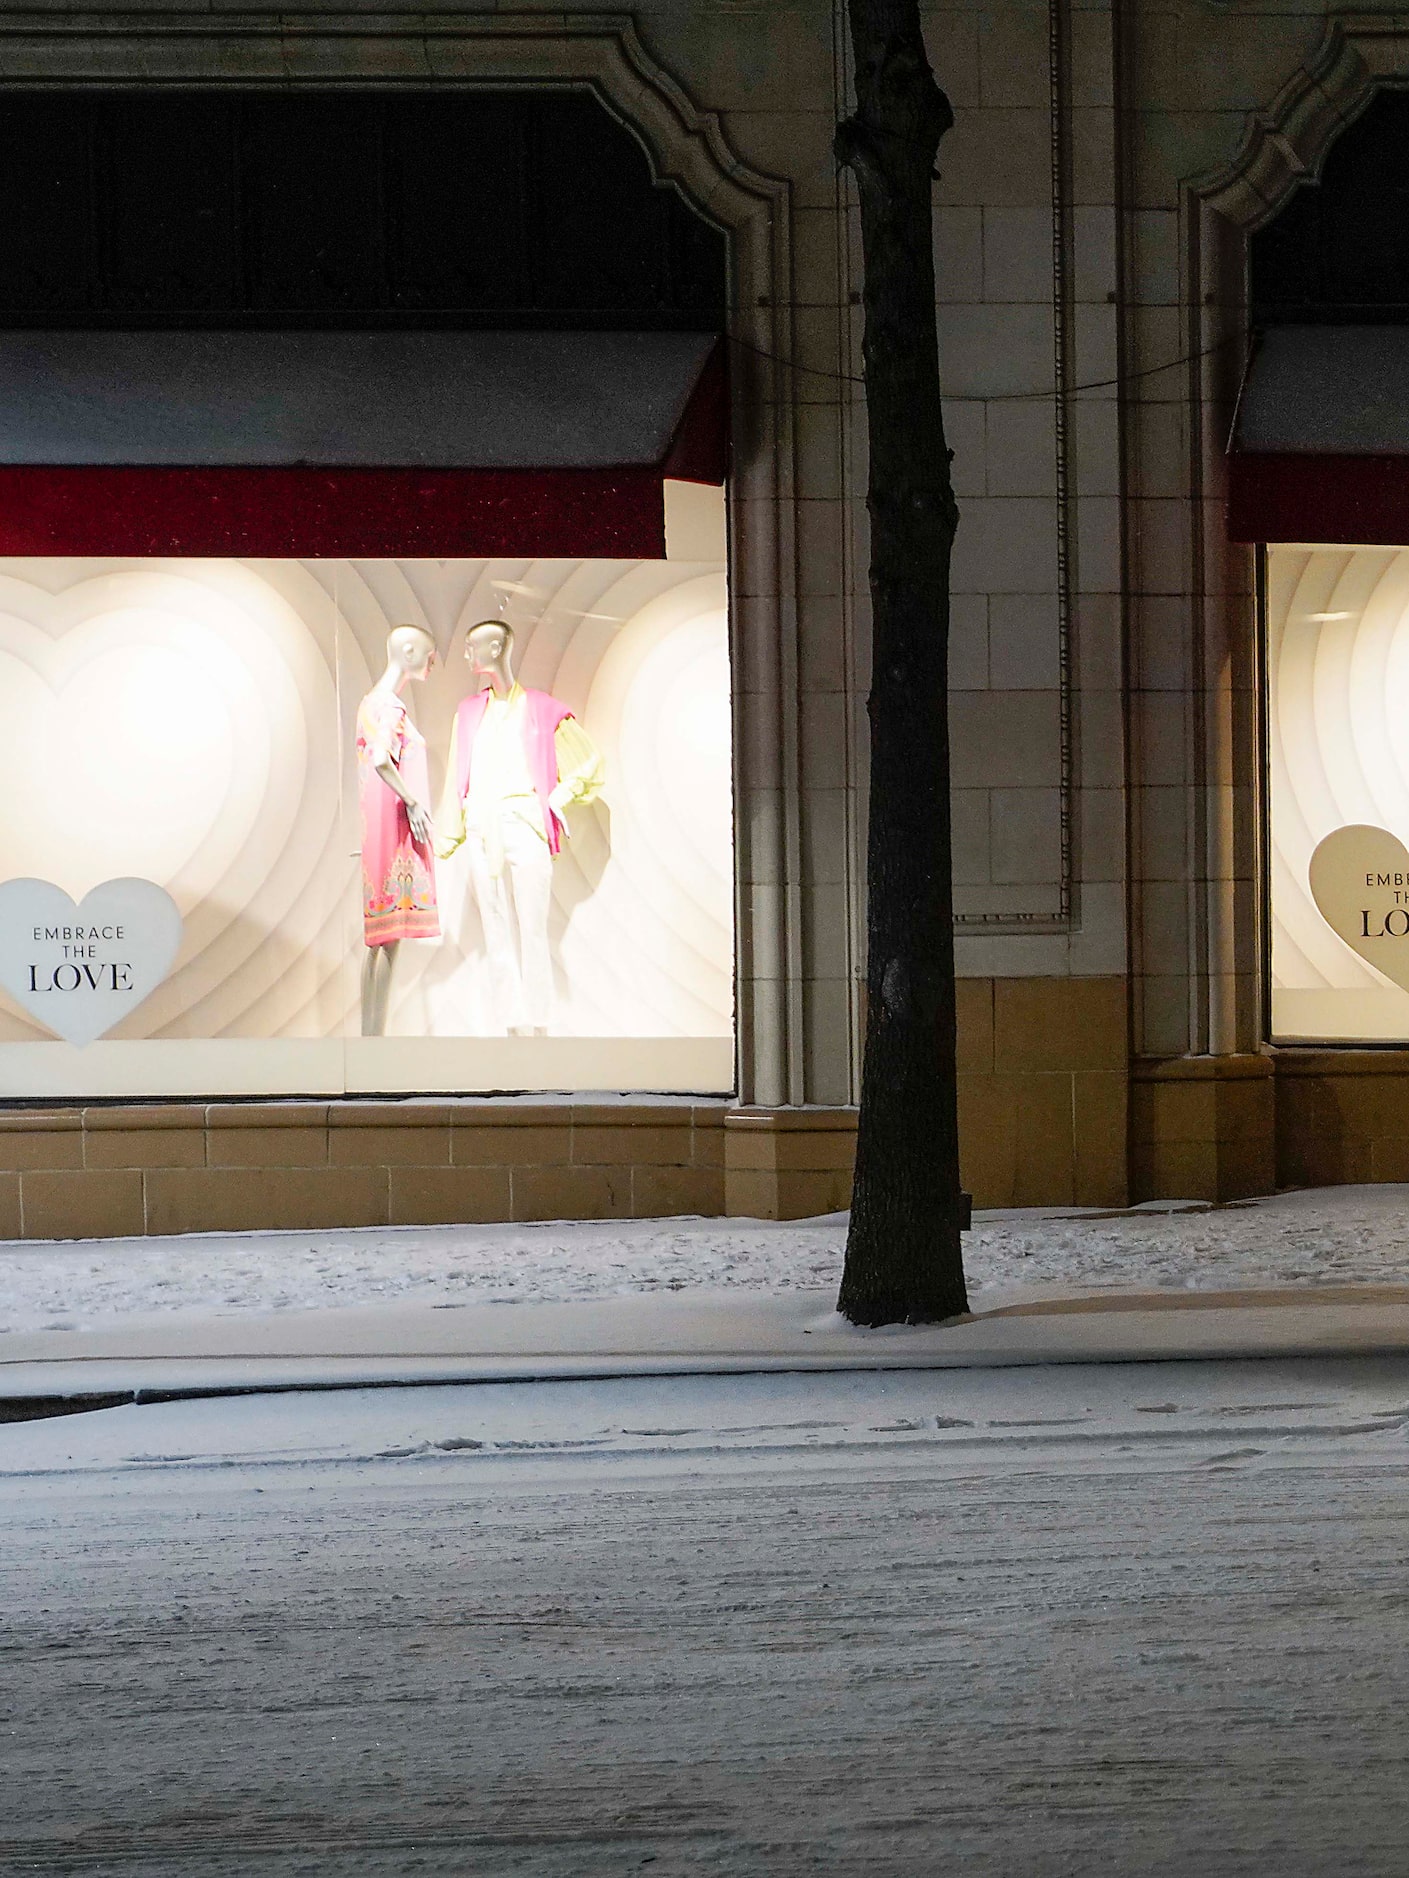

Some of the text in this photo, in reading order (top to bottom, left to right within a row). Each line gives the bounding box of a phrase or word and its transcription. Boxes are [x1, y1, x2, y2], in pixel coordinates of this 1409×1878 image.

[33, 926, 125, 940] EMBRACE
[62, 945, 96, 958] THE
[28, 963, 133, 992] LOVE
